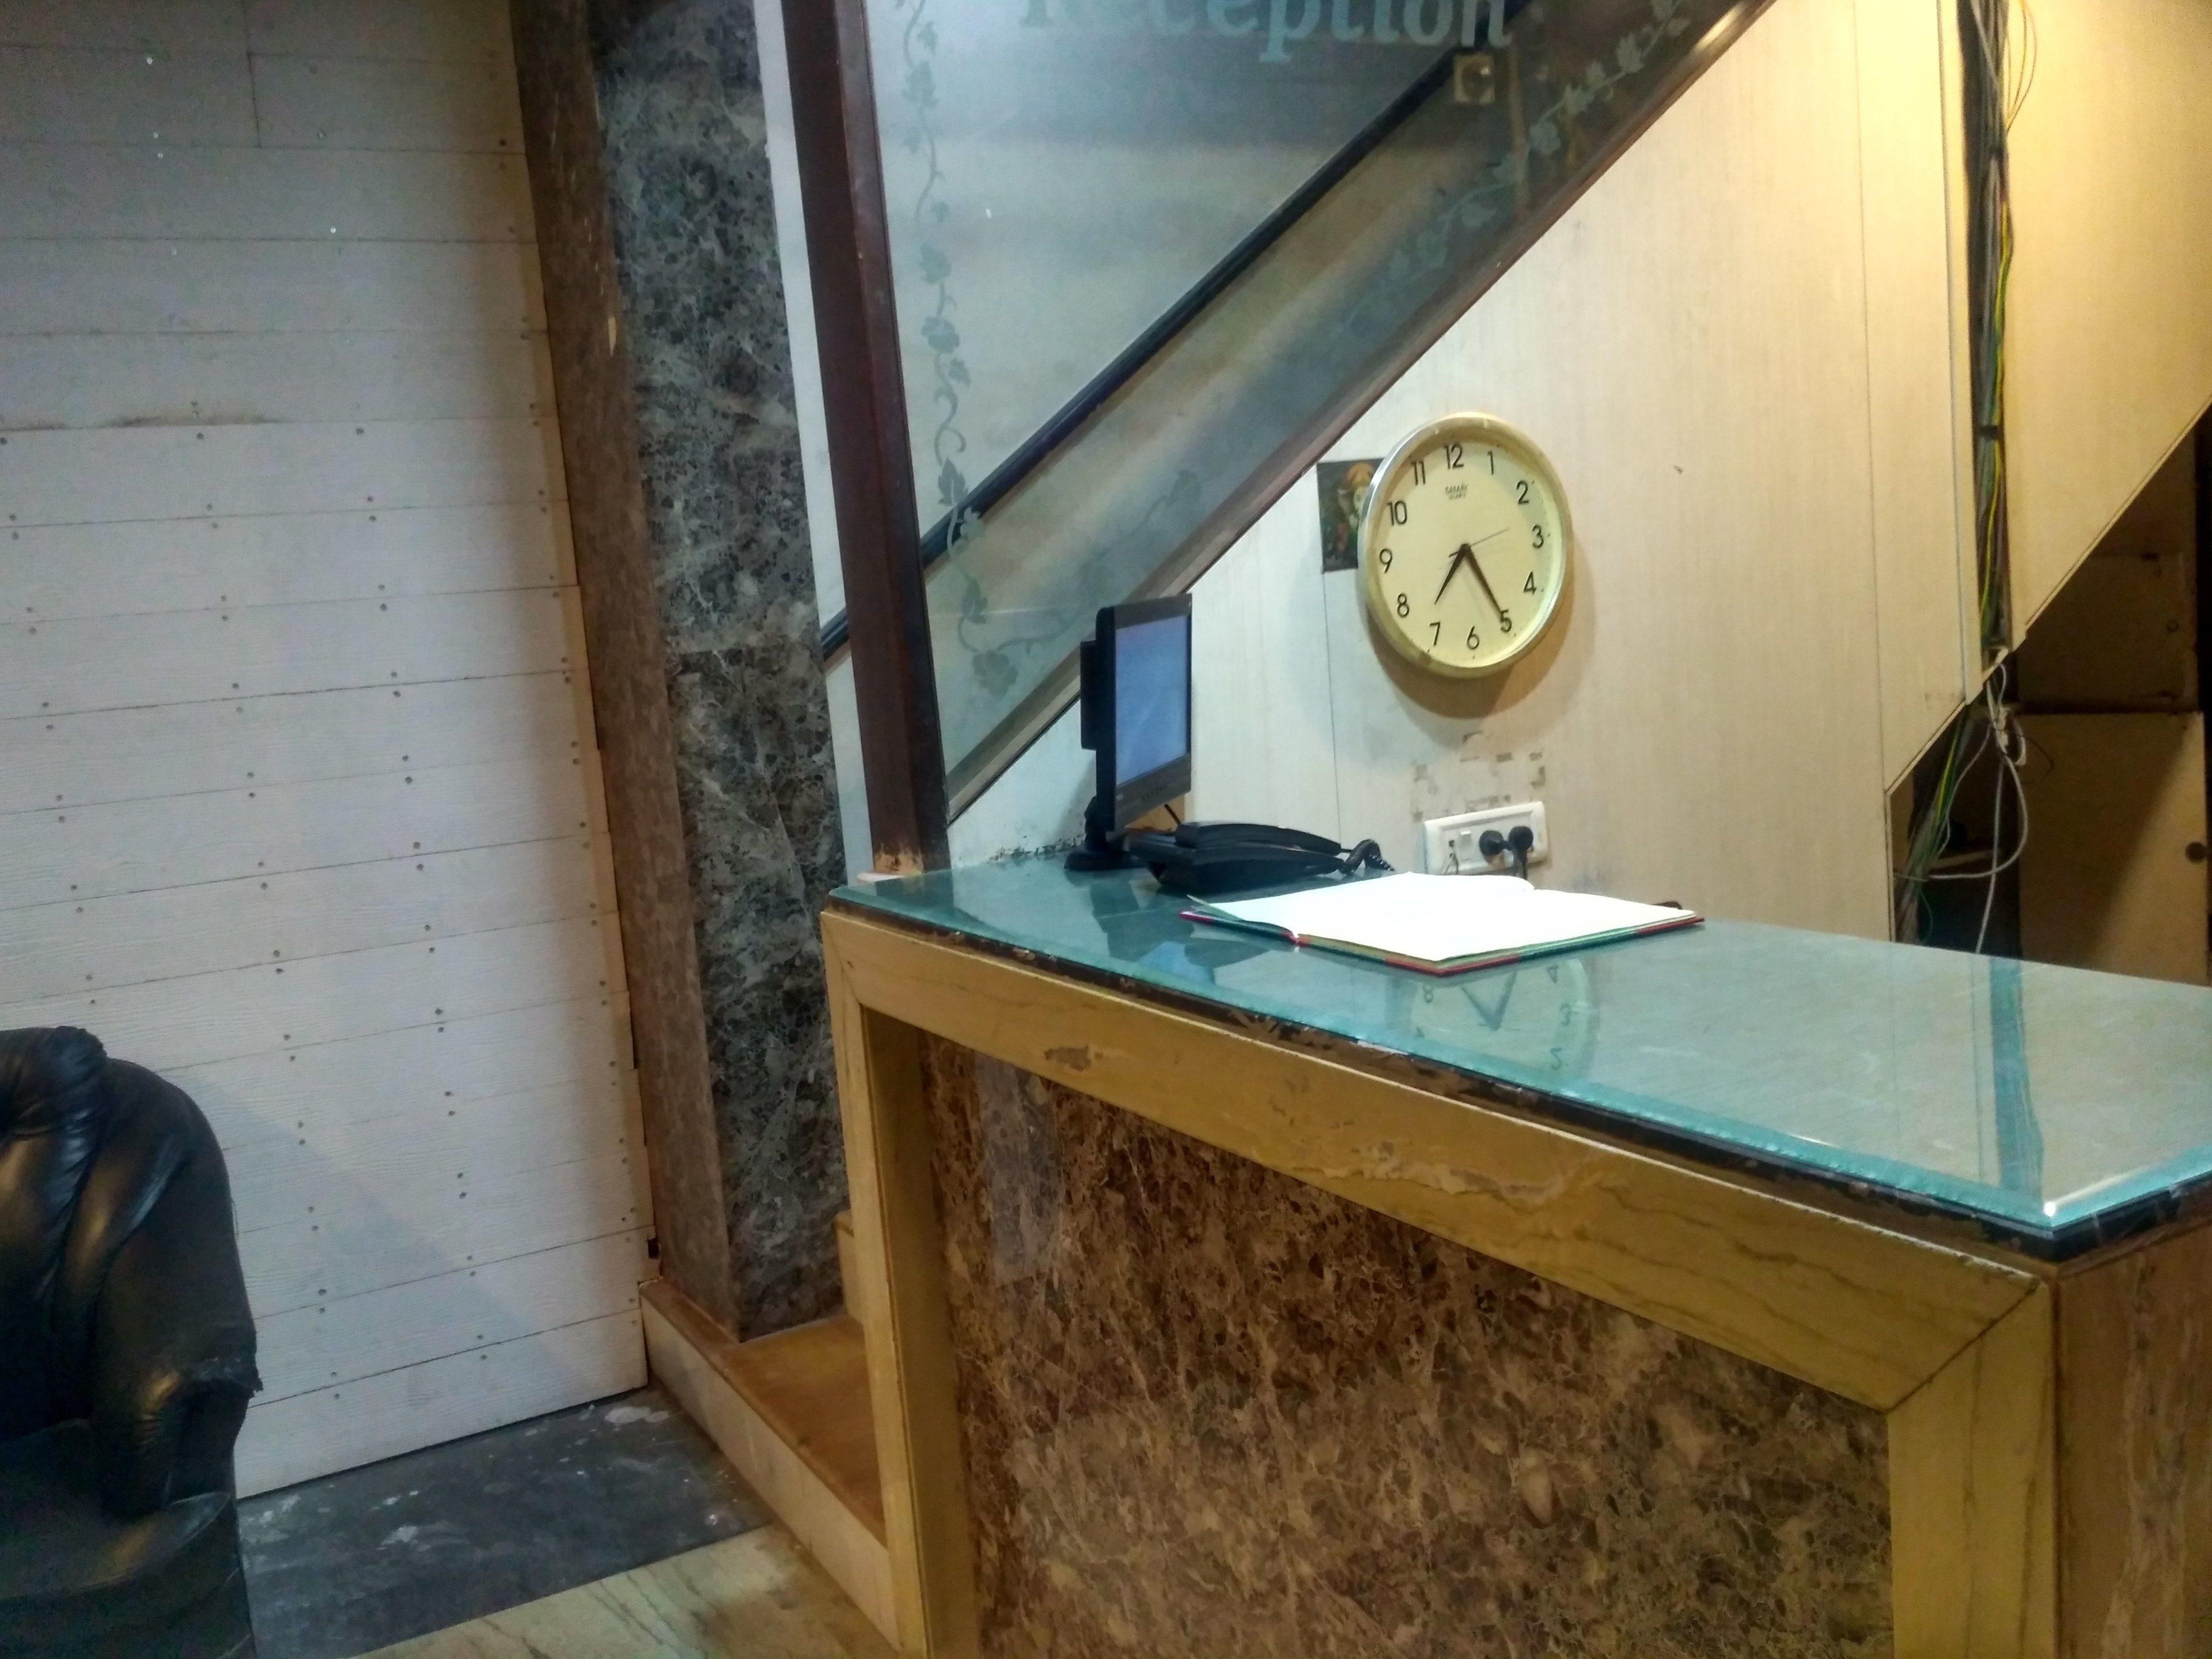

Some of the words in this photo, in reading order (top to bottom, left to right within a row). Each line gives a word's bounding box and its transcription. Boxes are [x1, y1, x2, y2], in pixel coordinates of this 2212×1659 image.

[1018, 0, 1513, 62] ception
[1444, 443, 1464, 469] 12
[1487, 450, 1494, 475] 1
[1411, 460, 1426, 486] 11
[1516, 480, 1529, 505] 2
[1387, 500, 1407, 526] 10
[1531, 525, 1544, 549] 3
[1379, 548, 1393, 574] 9
[1522, 570, 1537, 594] 4
[1397, 593, 1410, 618] 8
[1499, 608, 1512, 632] 5
[1429, 621, 1441, 646] 7
[1467, 626, 1480, 650] 6
